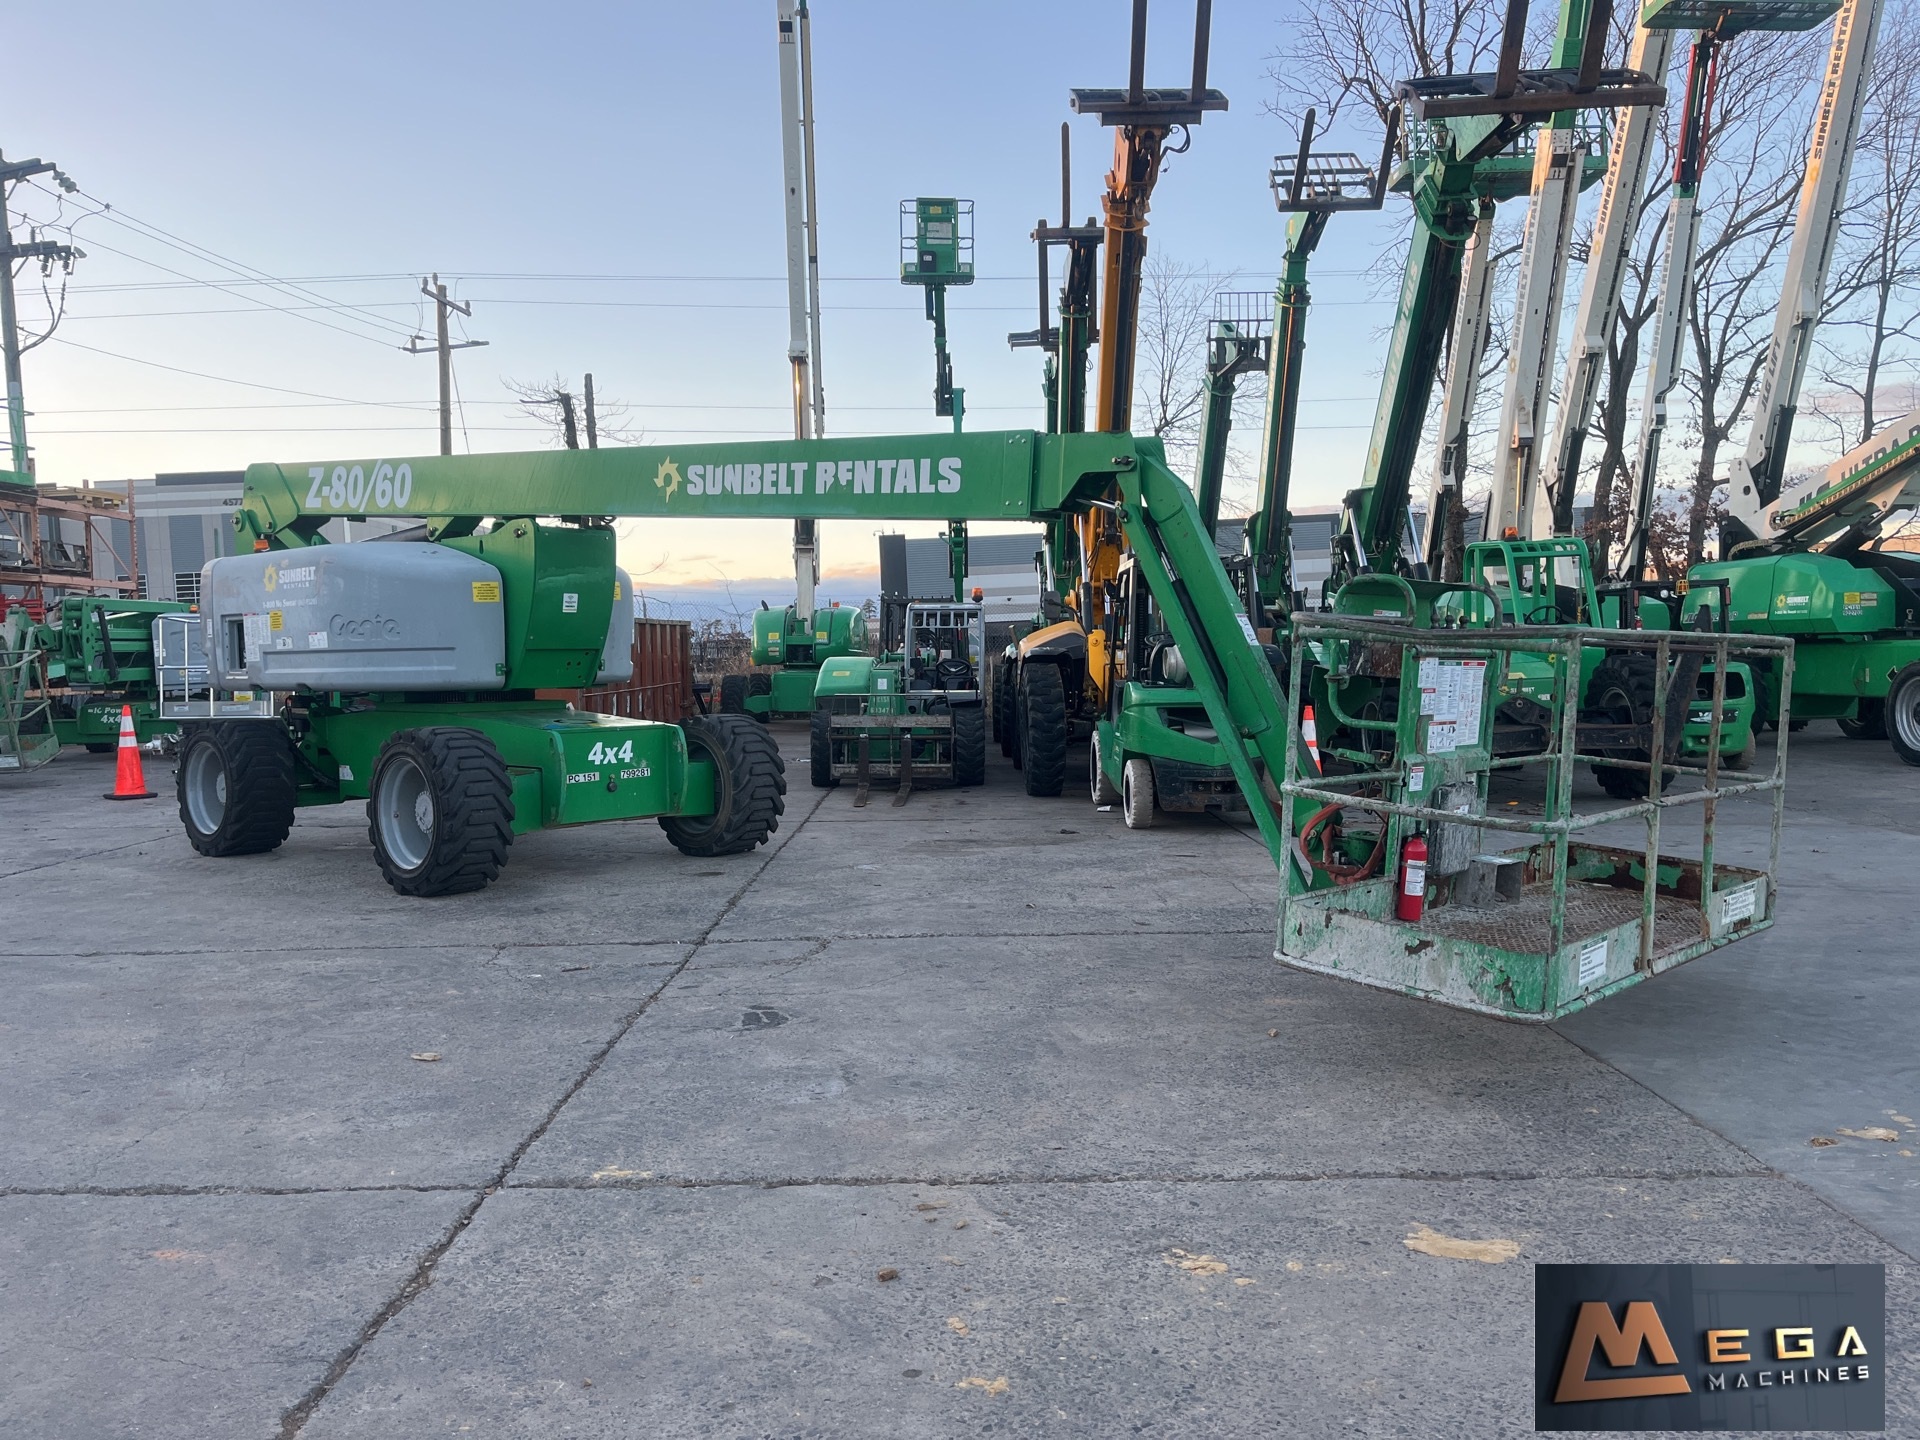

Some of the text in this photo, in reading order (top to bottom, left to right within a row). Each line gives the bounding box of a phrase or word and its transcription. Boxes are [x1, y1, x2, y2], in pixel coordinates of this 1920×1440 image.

[1814, 79, 1836, 160] SUNBELT
[1597, 105, 1630, 235] SUNBELT RENT
[1513, 183, 1541, 351] SUNBELT RENTALS
[1652, 211, 1676, 359] SUNBELT RENTALS
[1762, 336, 1781, 413] JLG LIFT
[305, 459, 413, 513] Z-80/60
[686, 457, 962, 495] SUNBELT RENTALS
[278, 566, 316, 583] SUNBELT
[283, 581, 310, 589] RENTALS
[329, 613, 401, 642] Genie
[100, 714, 121, 724] 4x4
[104, 706, 122, 714] Pow
[588, 740, 633, 765] 4x4
[568, 773, 596, 782] PC 151
[622, 768, 650, 778] 799281
